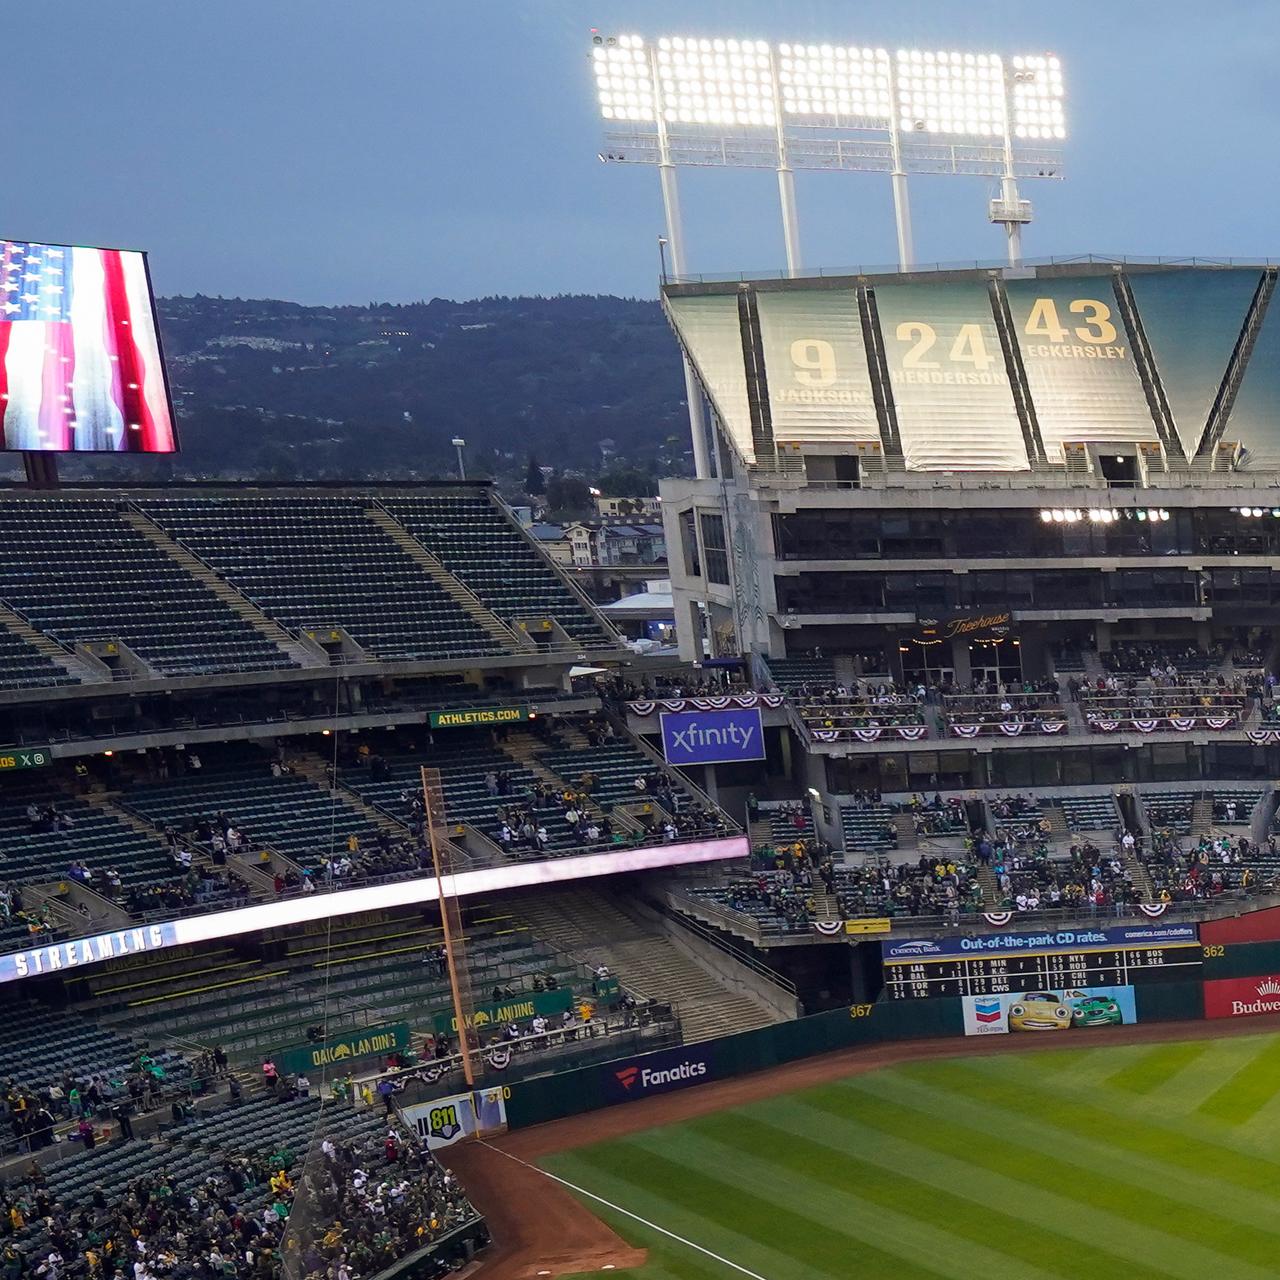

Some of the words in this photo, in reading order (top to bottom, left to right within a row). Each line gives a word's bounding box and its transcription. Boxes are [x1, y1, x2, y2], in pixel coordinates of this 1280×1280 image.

[1025, 298, 1117, 344] 43
[896, 321, 996, 370] 24
[1027, 344, 1126, 359] ECKERSLEY
[790, 338, 837, 388] 9
[893, 370, 1010, 385] HENDERSON
[944, 613, 1009, 638] Treehouse
[438, 710, 520, 725] ATHLETICS.COM
[671, 722, 754, 752] xfinity
[15, 926, 164, 976] STREAMING
[960, 933, 1055, 950] Out-of-the-park
[1056, 933, 1075, 944] CD
[1077, 931, 1108, 943] rates.
[1146, 950, 1163, 958] BOS
[1203, 945, 1225, 959] 362
[912, 982, 928, 990] TOR
[451, 1015, 473, 1032] OK
[641, 1060, 706, 1087] Fanatics
[430, 1105, 457, 1130] 811
